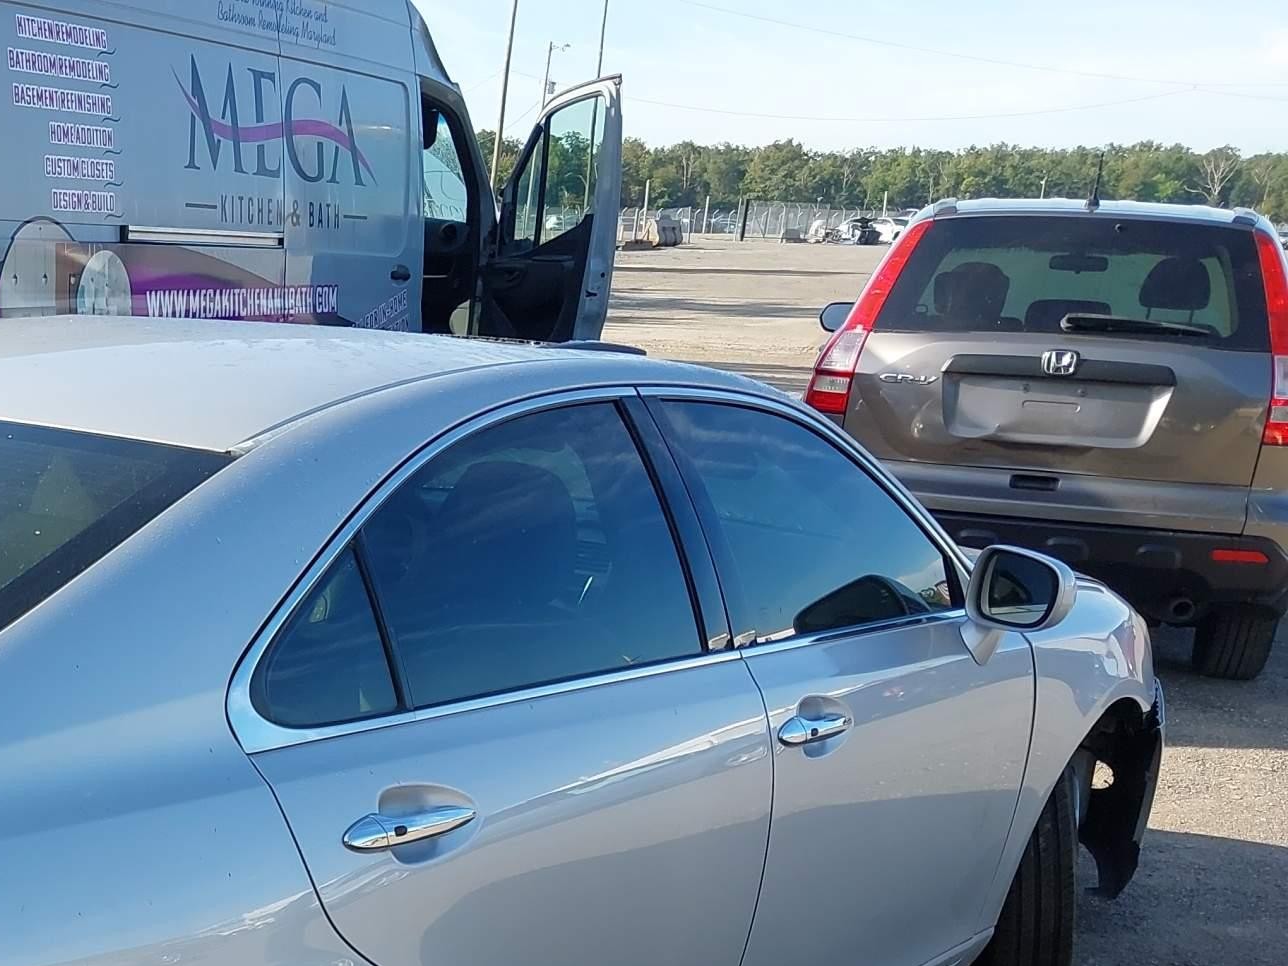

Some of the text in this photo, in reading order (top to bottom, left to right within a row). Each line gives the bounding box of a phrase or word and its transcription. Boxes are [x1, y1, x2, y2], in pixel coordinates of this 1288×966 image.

[217, 0, 256, 27] Bathroom
[16, 15, 107, 49] KITCHEN REMODELING
[8, 48, 110, 82] BATHROOM REMODELING
[13, 84, 111, 115] BASEMENT REFINISHING
[49, 123, 113, 148] HOME ADDITION
[184, 53, 367, 187] MEGA
[45, 156, 114, 180] CUSTOM CLOSETS
[53, 190, 115, 212] DESIGN & BUILD
[220, 194, 341, 229] KITCHEN & BATH
[146, 285, 338, 319] WWWMEGAKITCHENANDBATHCOM
[880, 372, 940, 386] CR-V
